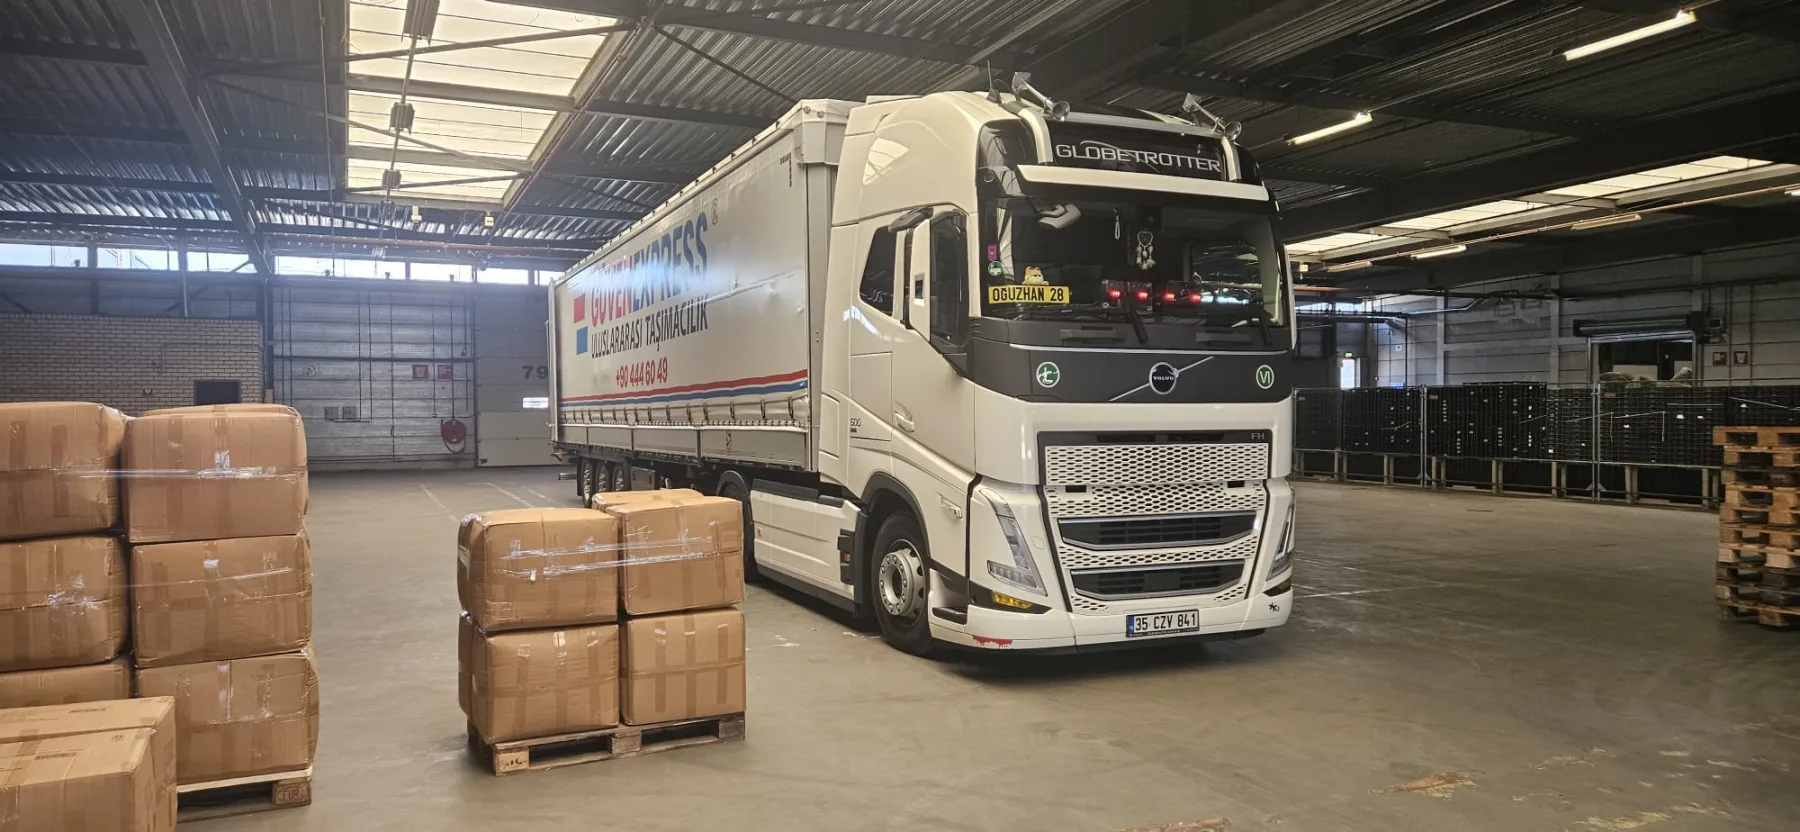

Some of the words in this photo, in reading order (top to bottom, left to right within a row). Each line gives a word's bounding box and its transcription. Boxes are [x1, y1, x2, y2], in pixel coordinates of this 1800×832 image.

[1055, 144, 1221, 173] GLOBETROTTER
[992, 287, 1045, 302] OĞUZHAN
[1050, 288, 1064, 302] 28
[591, 317, 643, 359] ULUSLARARASI
[522, 365, 549, 379] 79
[616, 365, 628, 388] +90
[630, 363, 644, 387] 444
[645, 360, 656, 386] 60
[657, 356, 668, 383] 49
[1259, 370, 1271, 384] VI
[1251, 432, 1265, 440] FH
[1135, 617, 1148, 631] 35
[1153, 614, 1173, 629] CZV
[1177, 612, 1196, 628] 841
